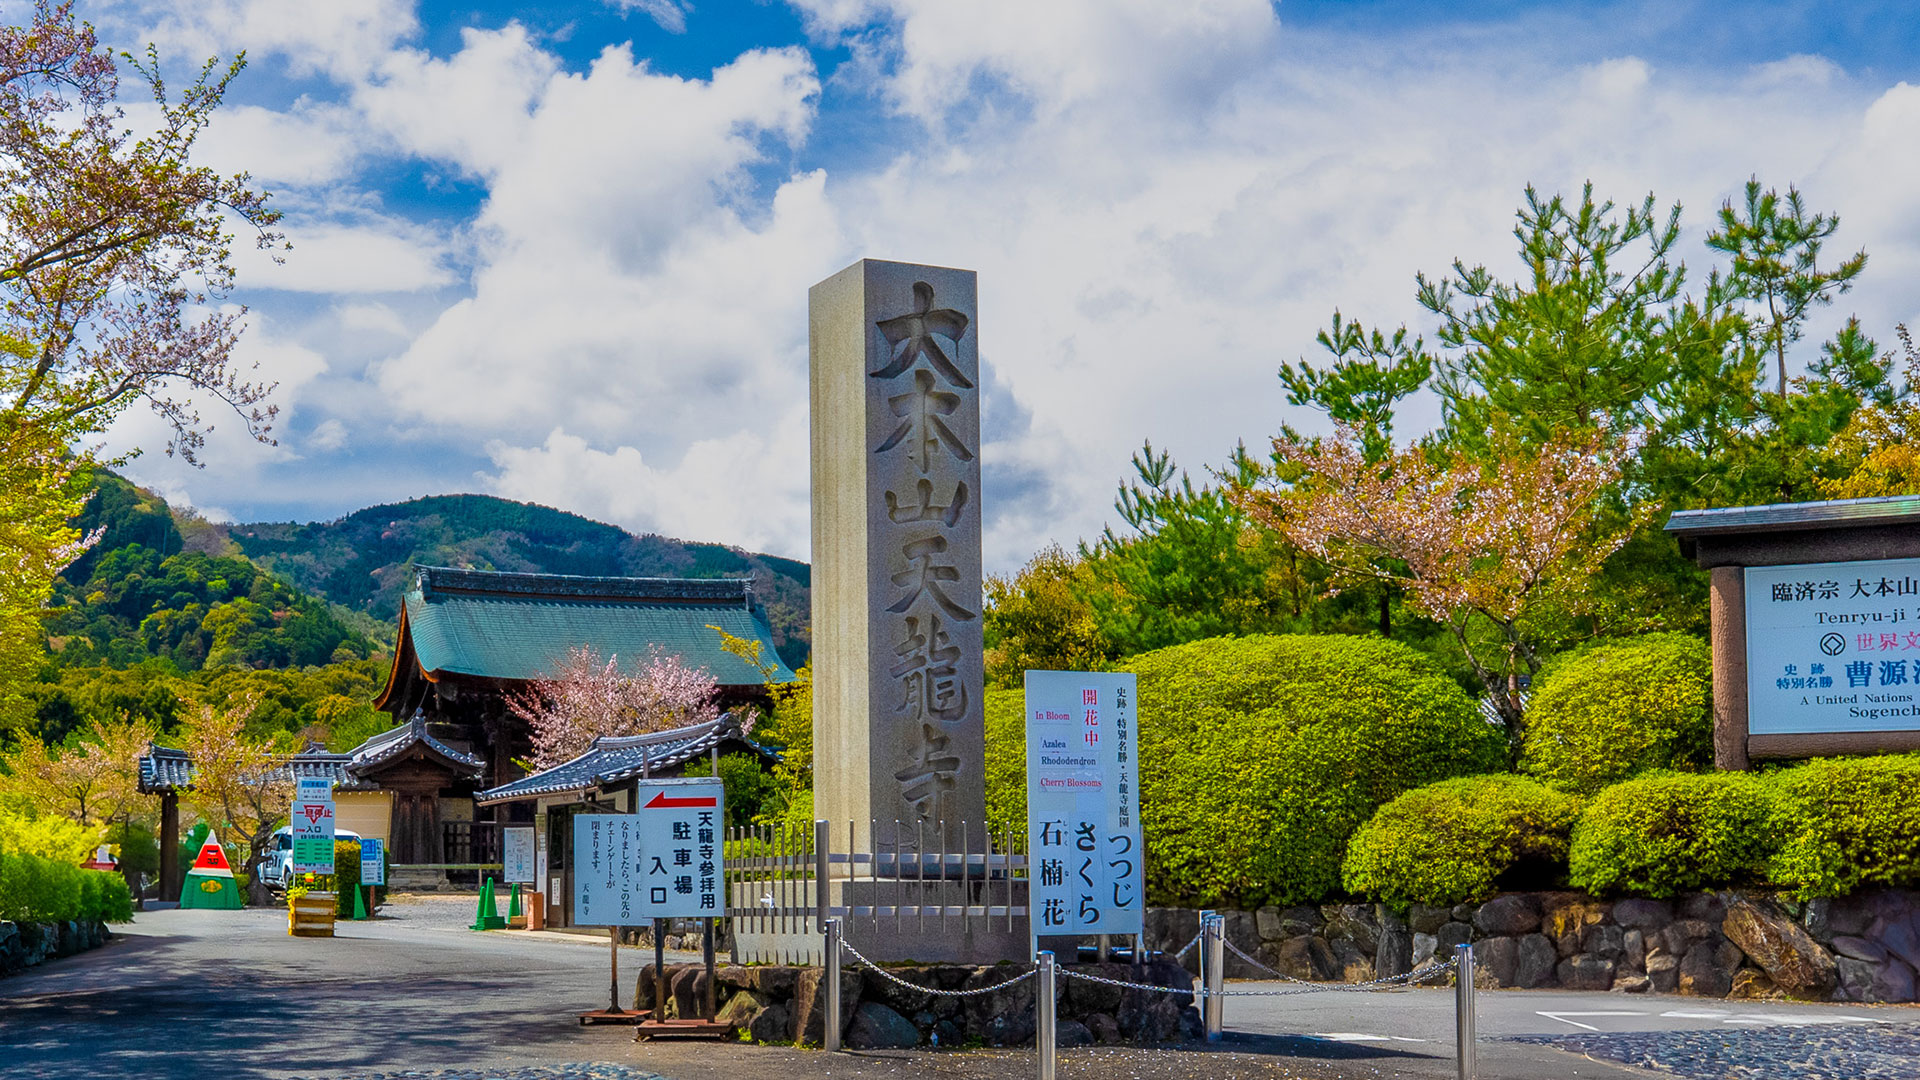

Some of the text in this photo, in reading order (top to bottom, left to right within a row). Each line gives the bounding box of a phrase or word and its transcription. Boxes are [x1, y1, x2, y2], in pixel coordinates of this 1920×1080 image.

[869, 280, 975, 836] 大本山天龍寺
[1772, 576, 1918, 603] 臨済宗 大本山
[1815, 608, 1906, 626] Tenryu-ji
[1856, 631, 1920, 653] 世界文
[1775, 676, 1834, 691] 特別名勝
[1800, 692, 1913, 706] A United Nations
[1035, 711, 1071, 721] In Bloom
[1083, 688, 1099, 748] 開花中
[1849, 704, 1920, 720] Sogench
[1041, 755, 1097, 766] Rhododendron
[1042, 739, 1067, 749] Azalea
[1040, 777, 1102, 788] Cherry Blossoms
[606, 820, 616, 890] チェーンゲートが
[621, 820, 630, 920] なりましたら、この先の
[672, 821, 694, 895] 駐車場
[697, 811, 716, 910] 天龍寺参拝用
[1039, 819, 1065, 927] 石楠花
[1074, 821, 1101, 925] さくら
[1107, 834, 1135, 909] つつじ
[649, 856, 668, 905] 入口
